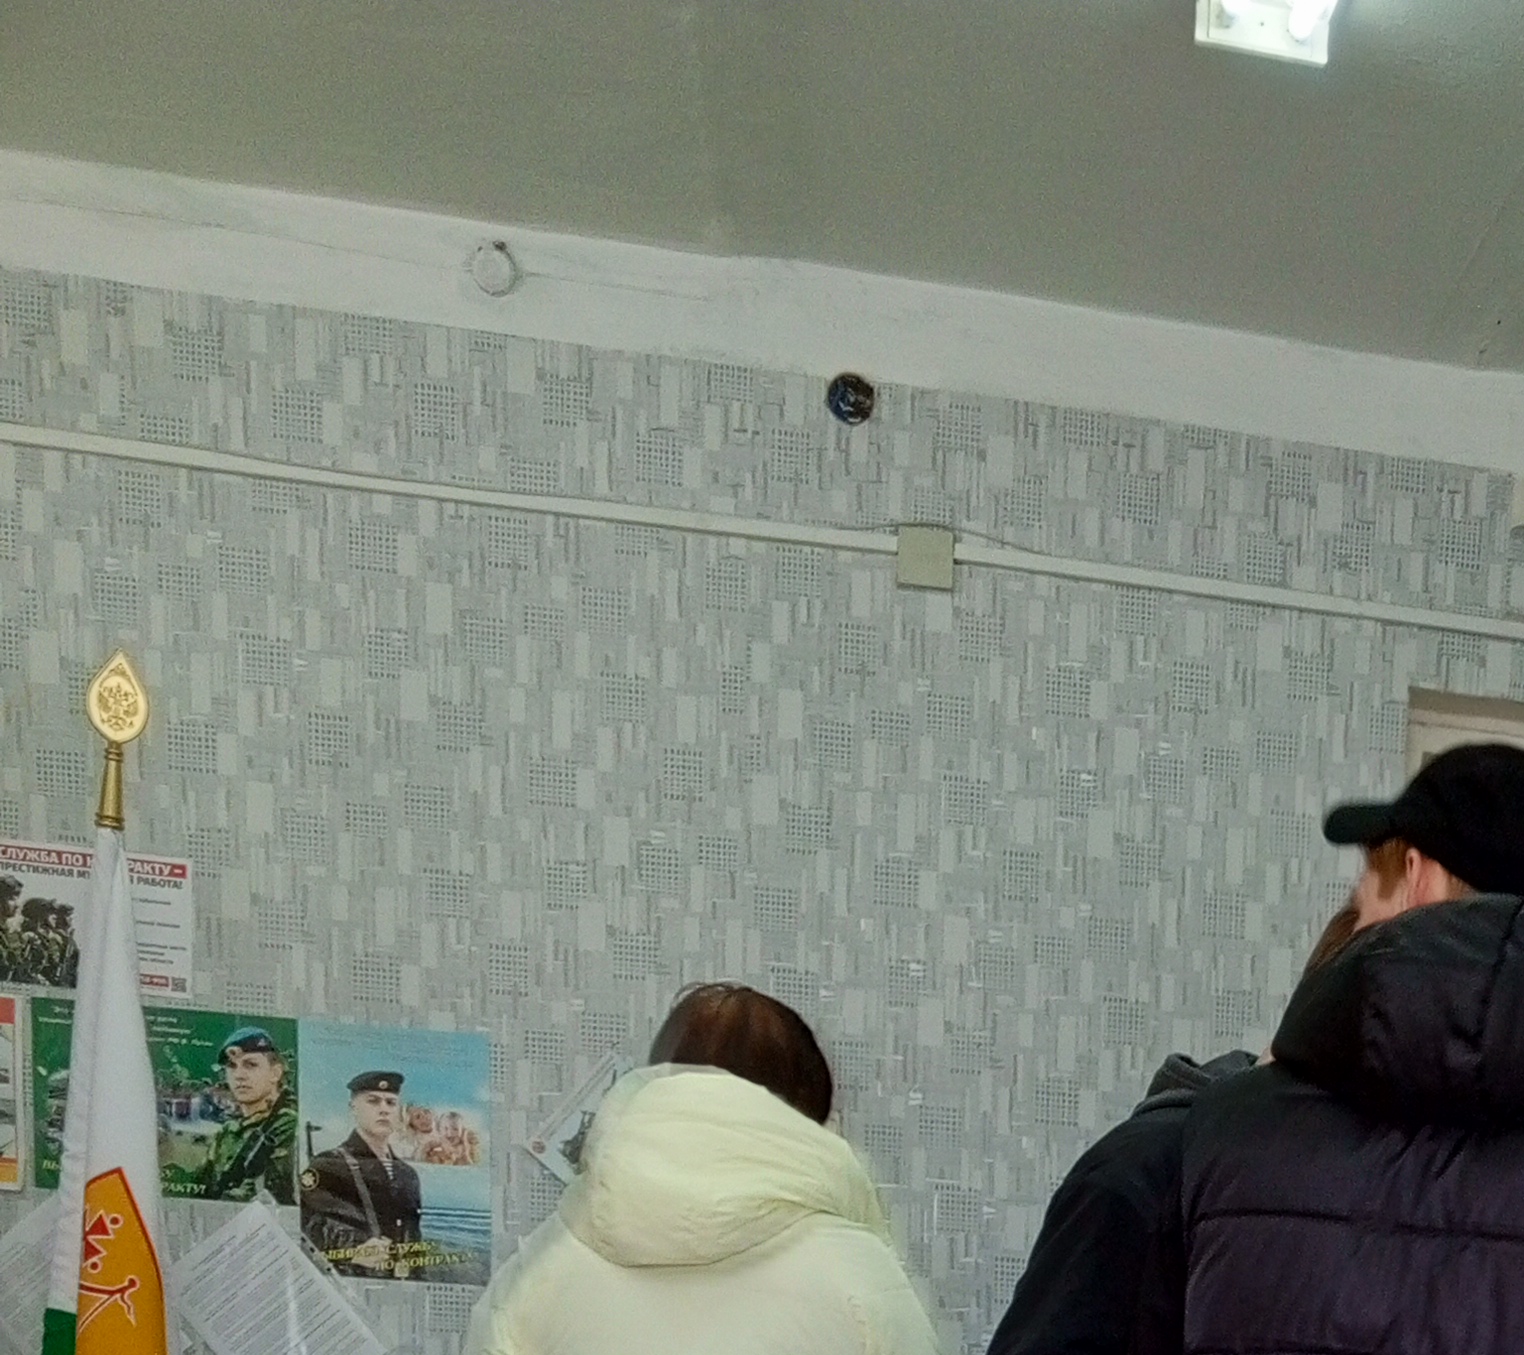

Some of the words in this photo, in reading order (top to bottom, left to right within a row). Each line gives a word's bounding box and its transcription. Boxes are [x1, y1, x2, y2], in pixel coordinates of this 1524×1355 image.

[0, 846, 59, 864] СЛУЖБА
[61, 853, 83, 866] ПО
[136, 876, 183, 890] РАБОТА!
